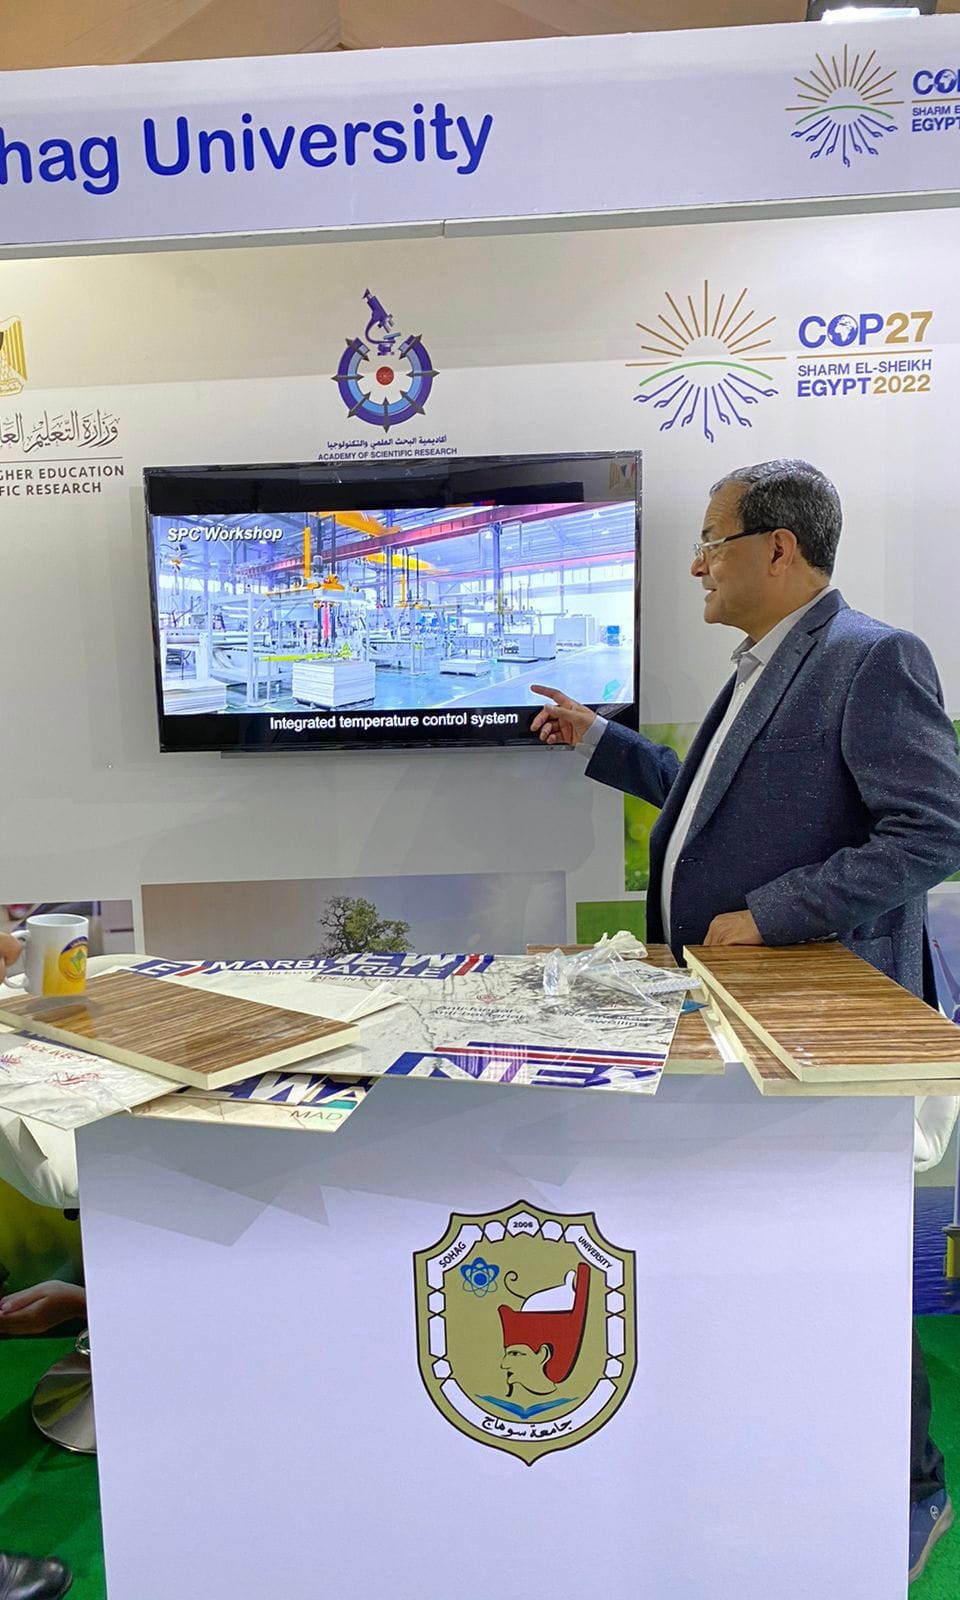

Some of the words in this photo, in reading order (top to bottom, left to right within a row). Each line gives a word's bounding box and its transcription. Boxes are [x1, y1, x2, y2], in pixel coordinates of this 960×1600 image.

[913, 68, 960, 95] CO
[912, 105, 951, 116] SHARM
[143, 103, 493, 176] University
[798, 311, 933, 348] COP27
[798, 363, 850, 377] SHARM
[855, 359, 932, 374] EL-SHEIKH
[797, 377, 871, 397] EGYPT
[873, 374, 931, 394] 2022
[370, 438, 394, 449] العلمي
[395, 437, 417, 446] البحث
[318, 452, 356, 461] ACADEMY
[358, 451, 369, 459] OF
[370, 449, 413, 458] SCIENTIFIC
[414, 447, 457, 456] RESEARCH
[0, 468, 33, 481] HER
[39, 465, 124, 479] EDUCATION
[26, 481, 101, 496] RESEARCH
[167, 527, 202, 542] SPC
[204, 525, 283, 543] Workshop
[270, 715, 336, 732] Integrated
[339, 714, 419, 730] temperature
[422, 712, 467, 726] control
[471, 712, 518, 727] system
[290, 1110, 343, 1121] MAD
[439, 1241, 467, 1269] SOHAG
[513, 1221, 534, 1229] 2006
[577, 1236, 614, 1269] UNIVERSITY
[481, 1415, 526, 1438] سوهاج
[529, 1419, 573, 1438] جامعة
